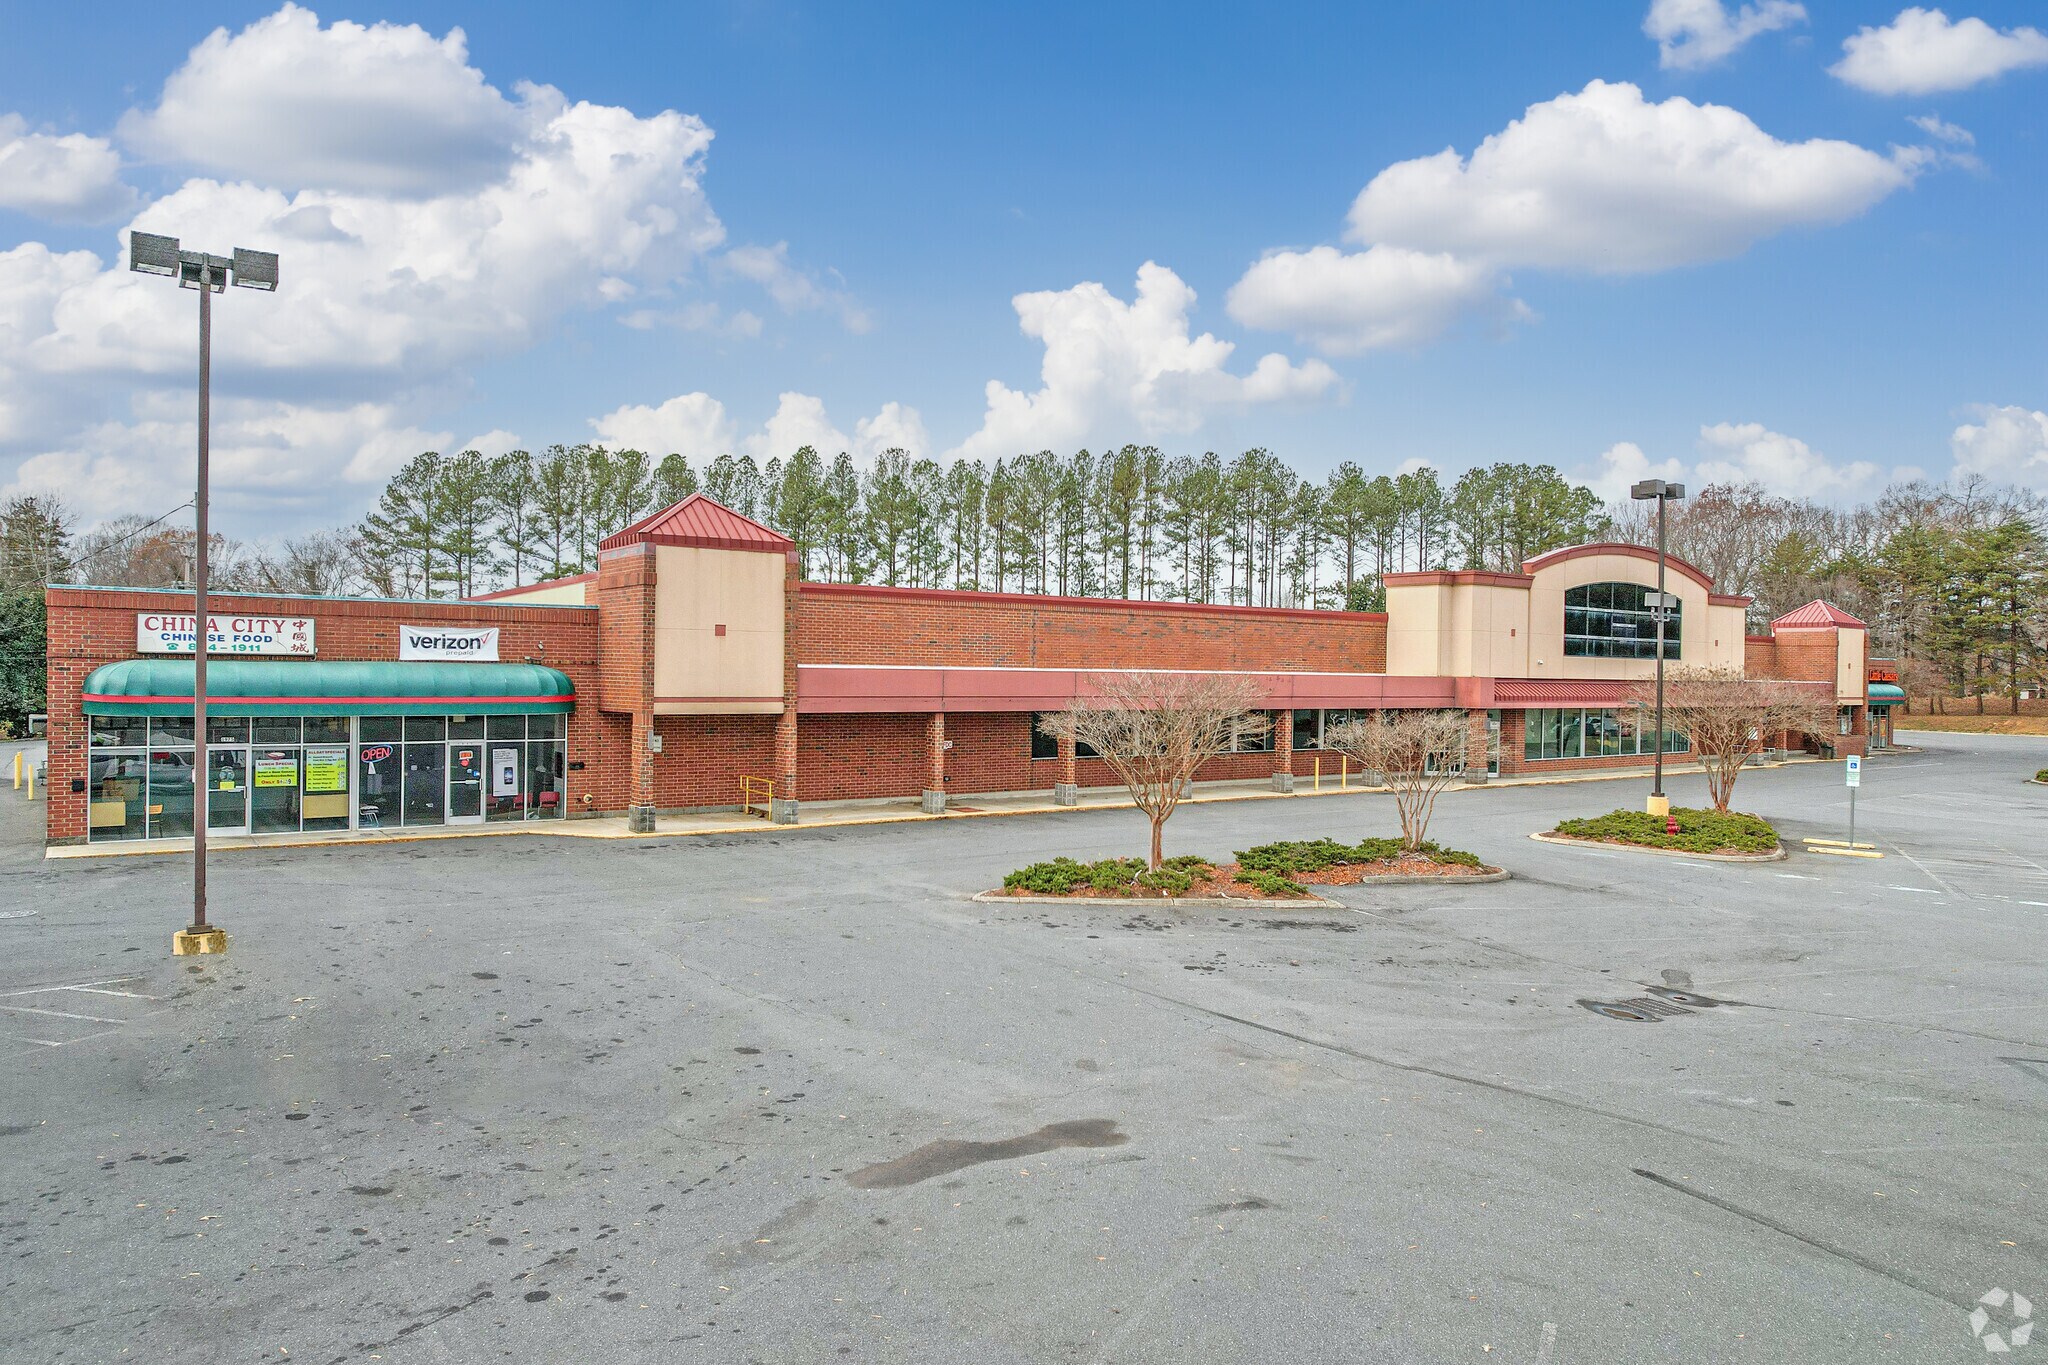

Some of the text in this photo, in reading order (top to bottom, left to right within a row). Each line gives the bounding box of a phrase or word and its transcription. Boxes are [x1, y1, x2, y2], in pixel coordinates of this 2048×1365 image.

[231, 618, 287, 634] CITY
[161, 633, 273, 643] CHINSE FOOD
[409, 633, 482, 650] verizon
[188, 643, 261, 652] 84-1911
[361, 747, 390, 761] OPEN
